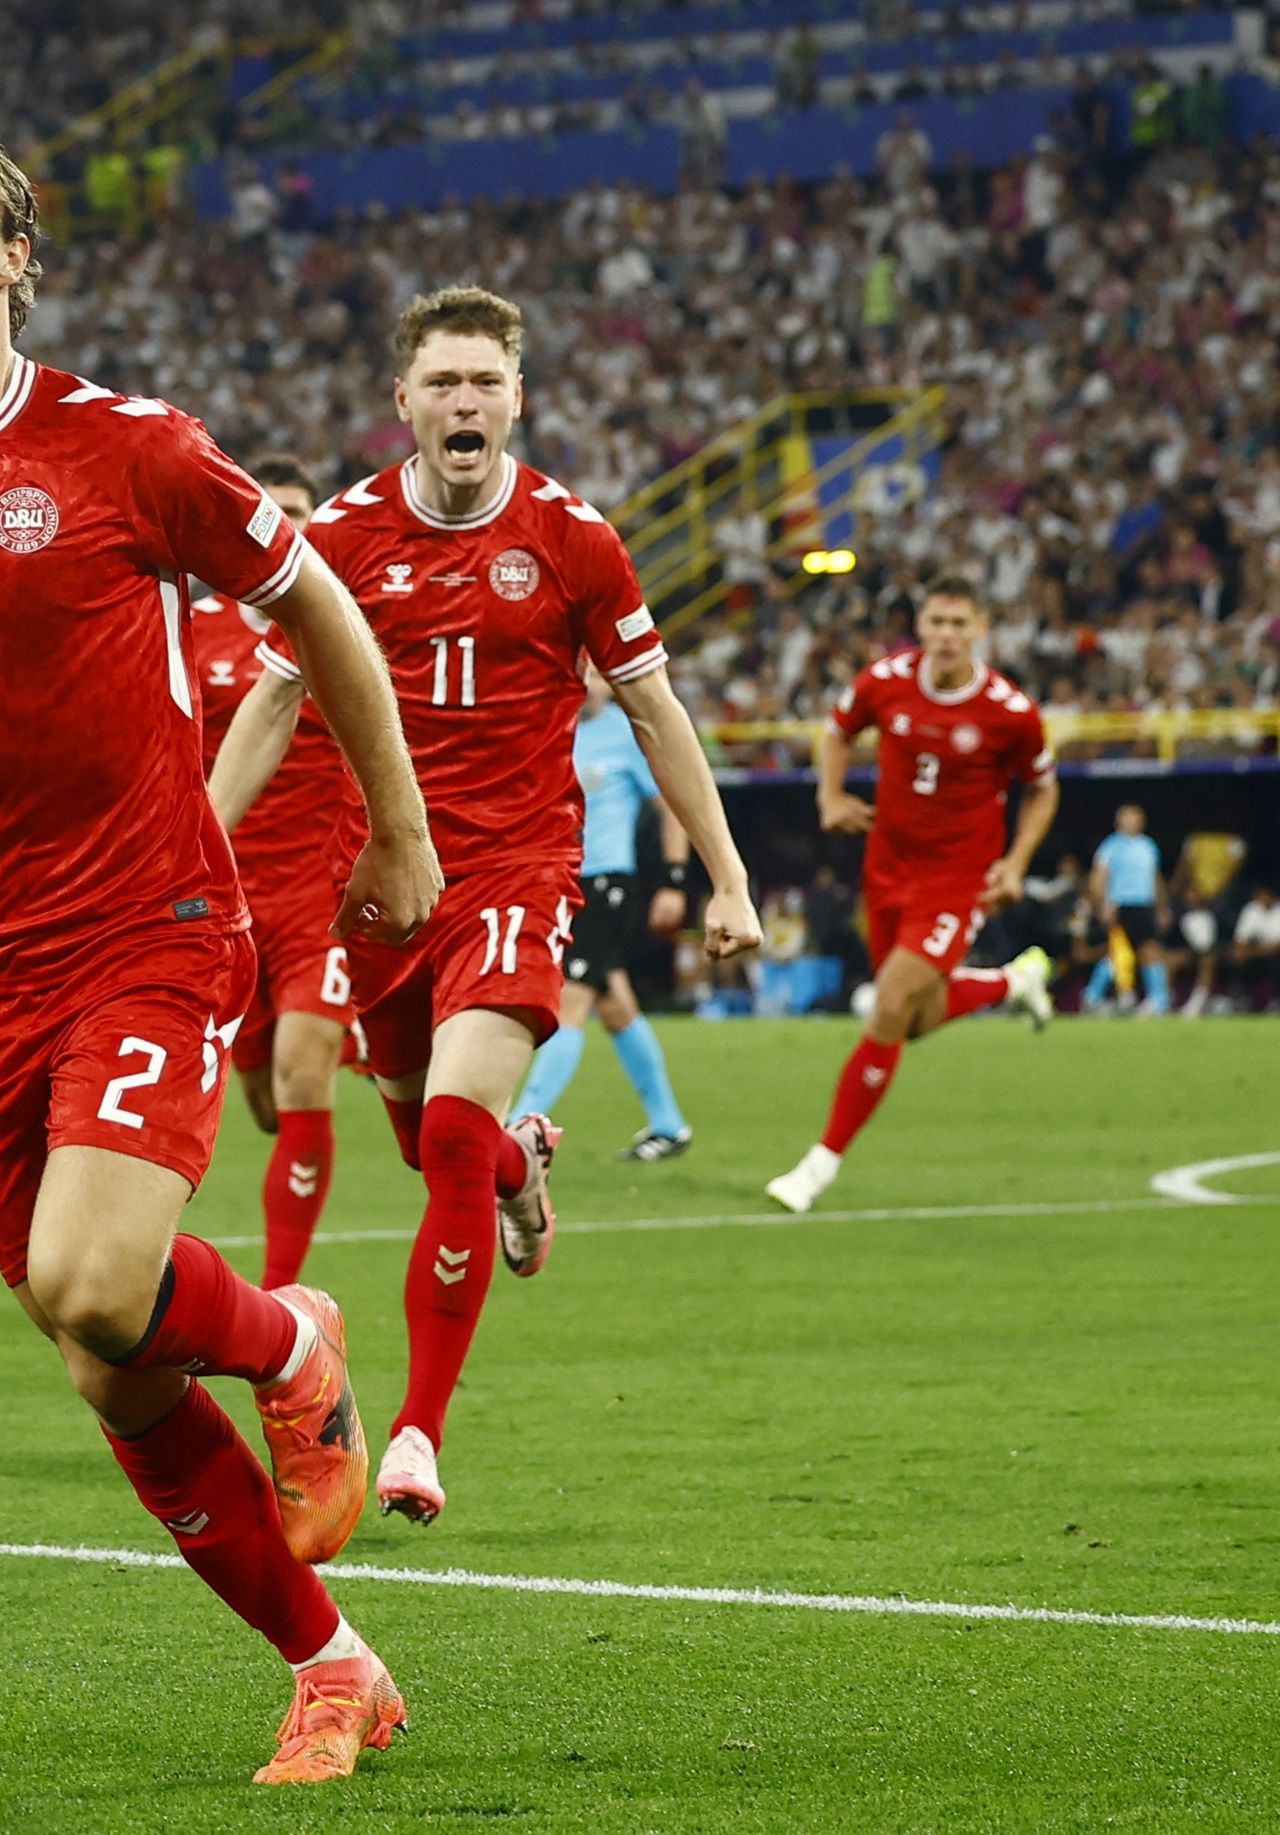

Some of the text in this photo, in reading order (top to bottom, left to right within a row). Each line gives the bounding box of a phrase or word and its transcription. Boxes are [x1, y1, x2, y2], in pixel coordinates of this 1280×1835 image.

[3, 508, 44, 529] DBU
[40, 505, 56, 542] UNION
[429, 636, 476, 707] 11
[912, 753, 940, 796] 3
[478, 905, 526, 976] 11
[922, 912, 961, 957] 3
[320, 946, 351, 1006] 6
[97, 1036, 167, 1129] 2
